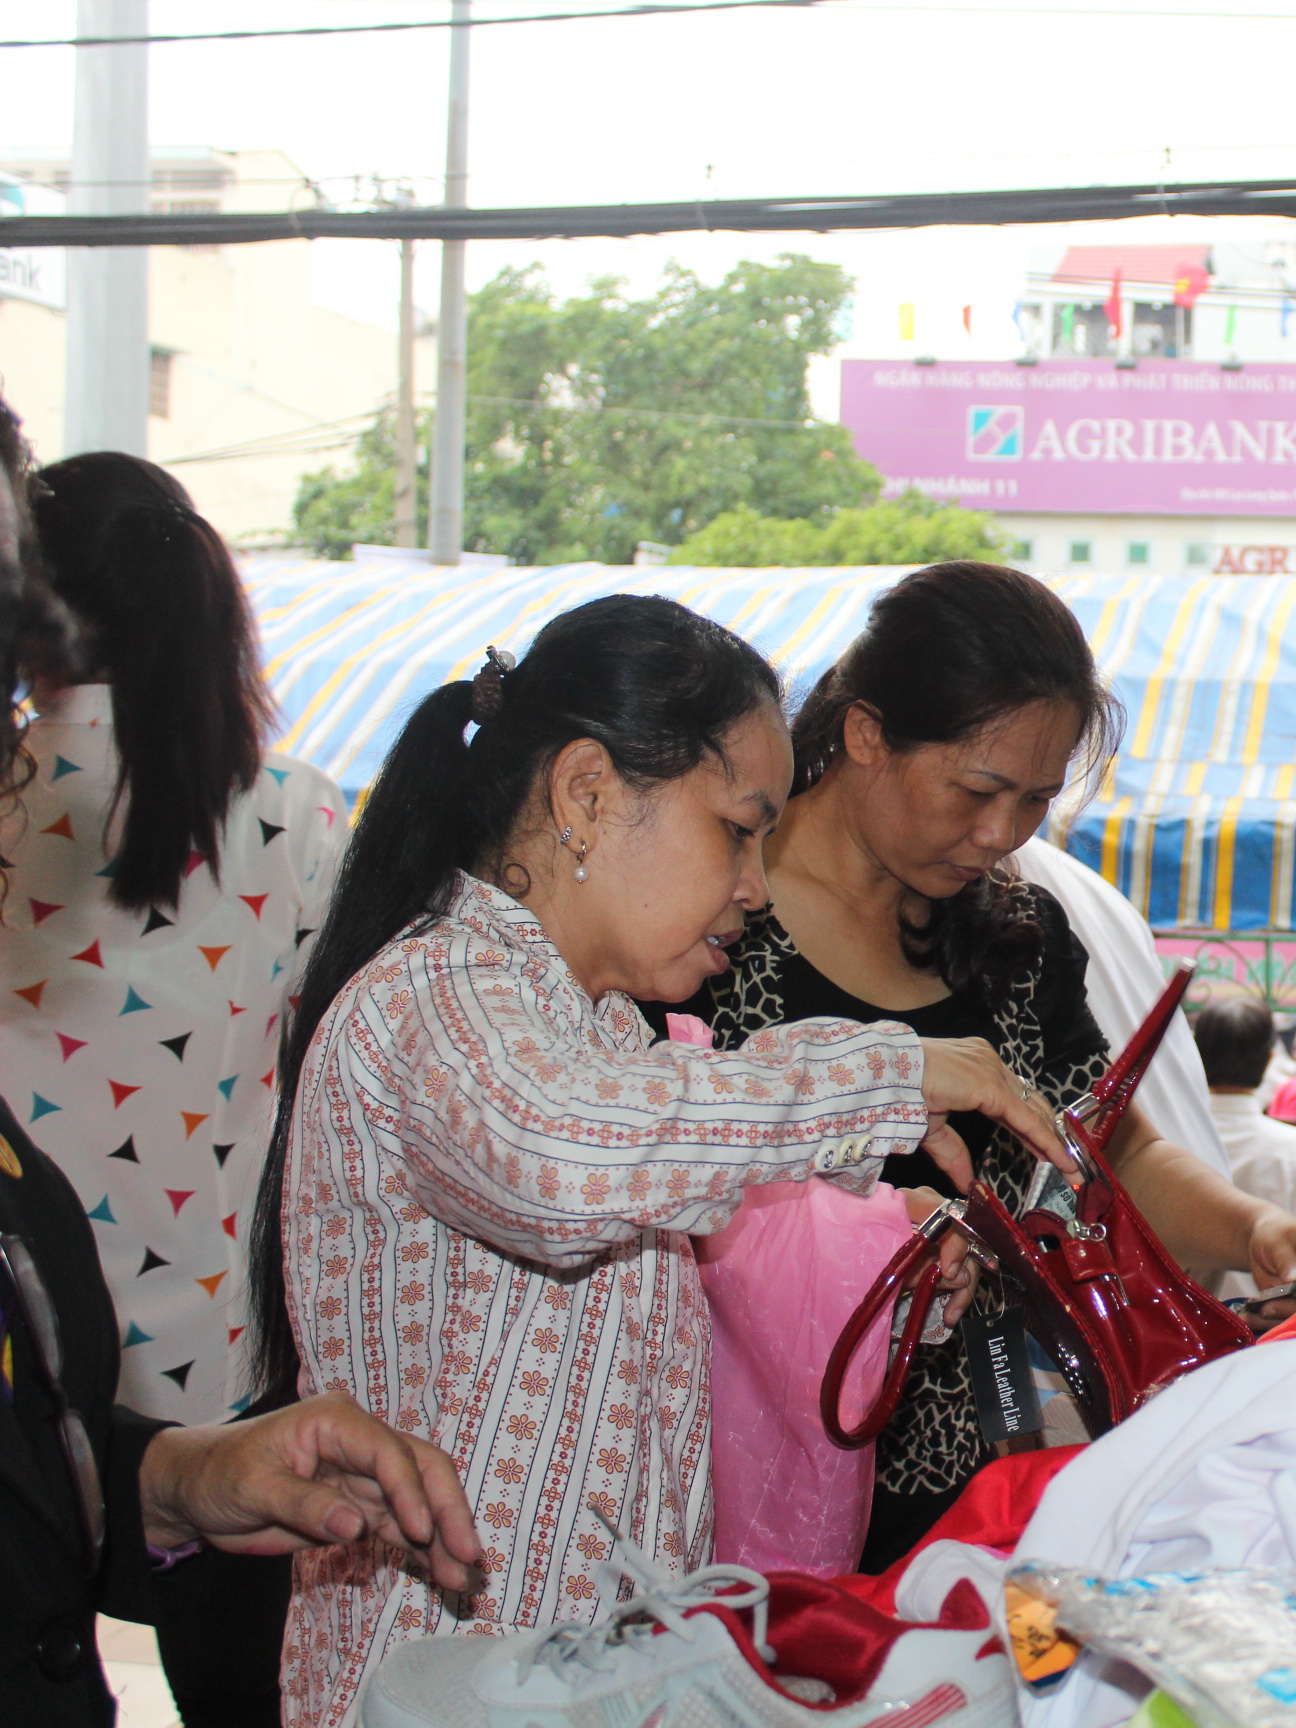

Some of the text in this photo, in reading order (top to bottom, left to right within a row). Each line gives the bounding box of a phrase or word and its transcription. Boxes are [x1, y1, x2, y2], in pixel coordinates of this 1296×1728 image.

[0, 252, 41, 291] ank
[988, 1335, 1022, 1432] Lin Fa Leather Line
